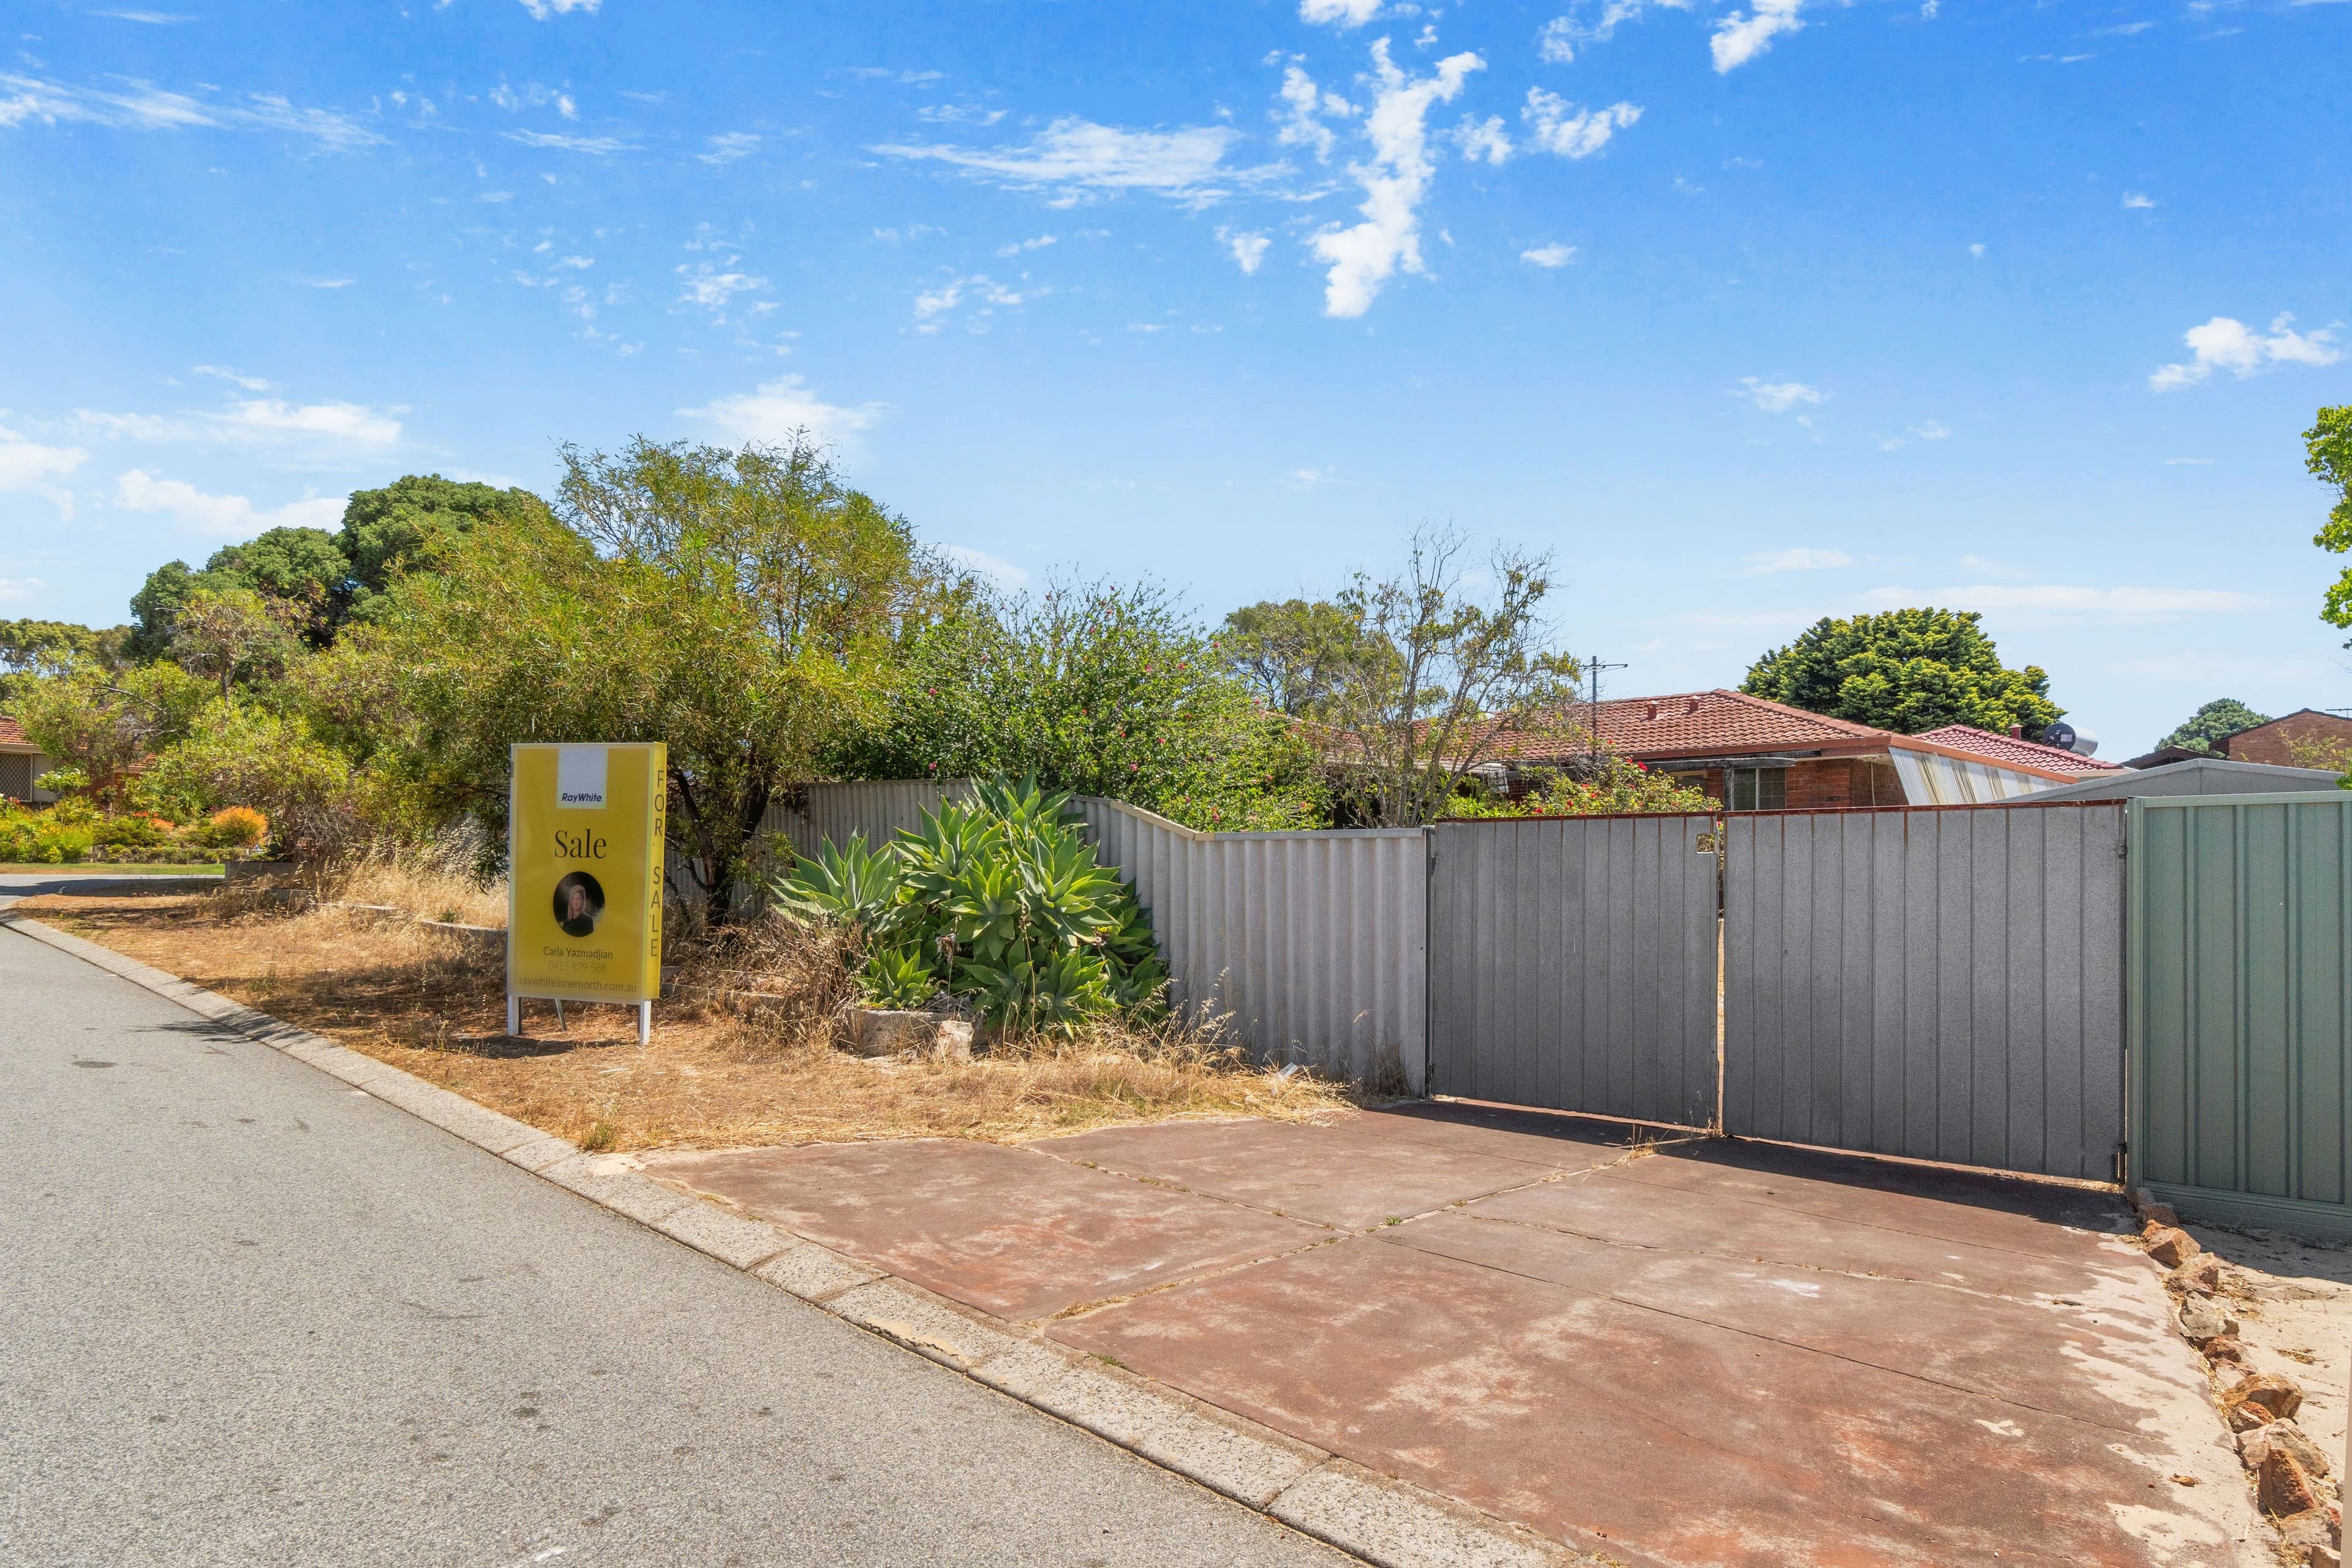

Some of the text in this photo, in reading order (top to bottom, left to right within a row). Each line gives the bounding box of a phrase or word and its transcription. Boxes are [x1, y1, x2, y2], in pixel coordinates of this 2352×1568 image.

[562, 793, 602, 803] RayWhite
[554, 829, 607, 859] Sale
[650, 770, 665, 957] FOR SALE
[543, 946, 613, 960] Carla Yazmadjian
[519, 976, 637, 992] raywhiteinnernorth.com.au
